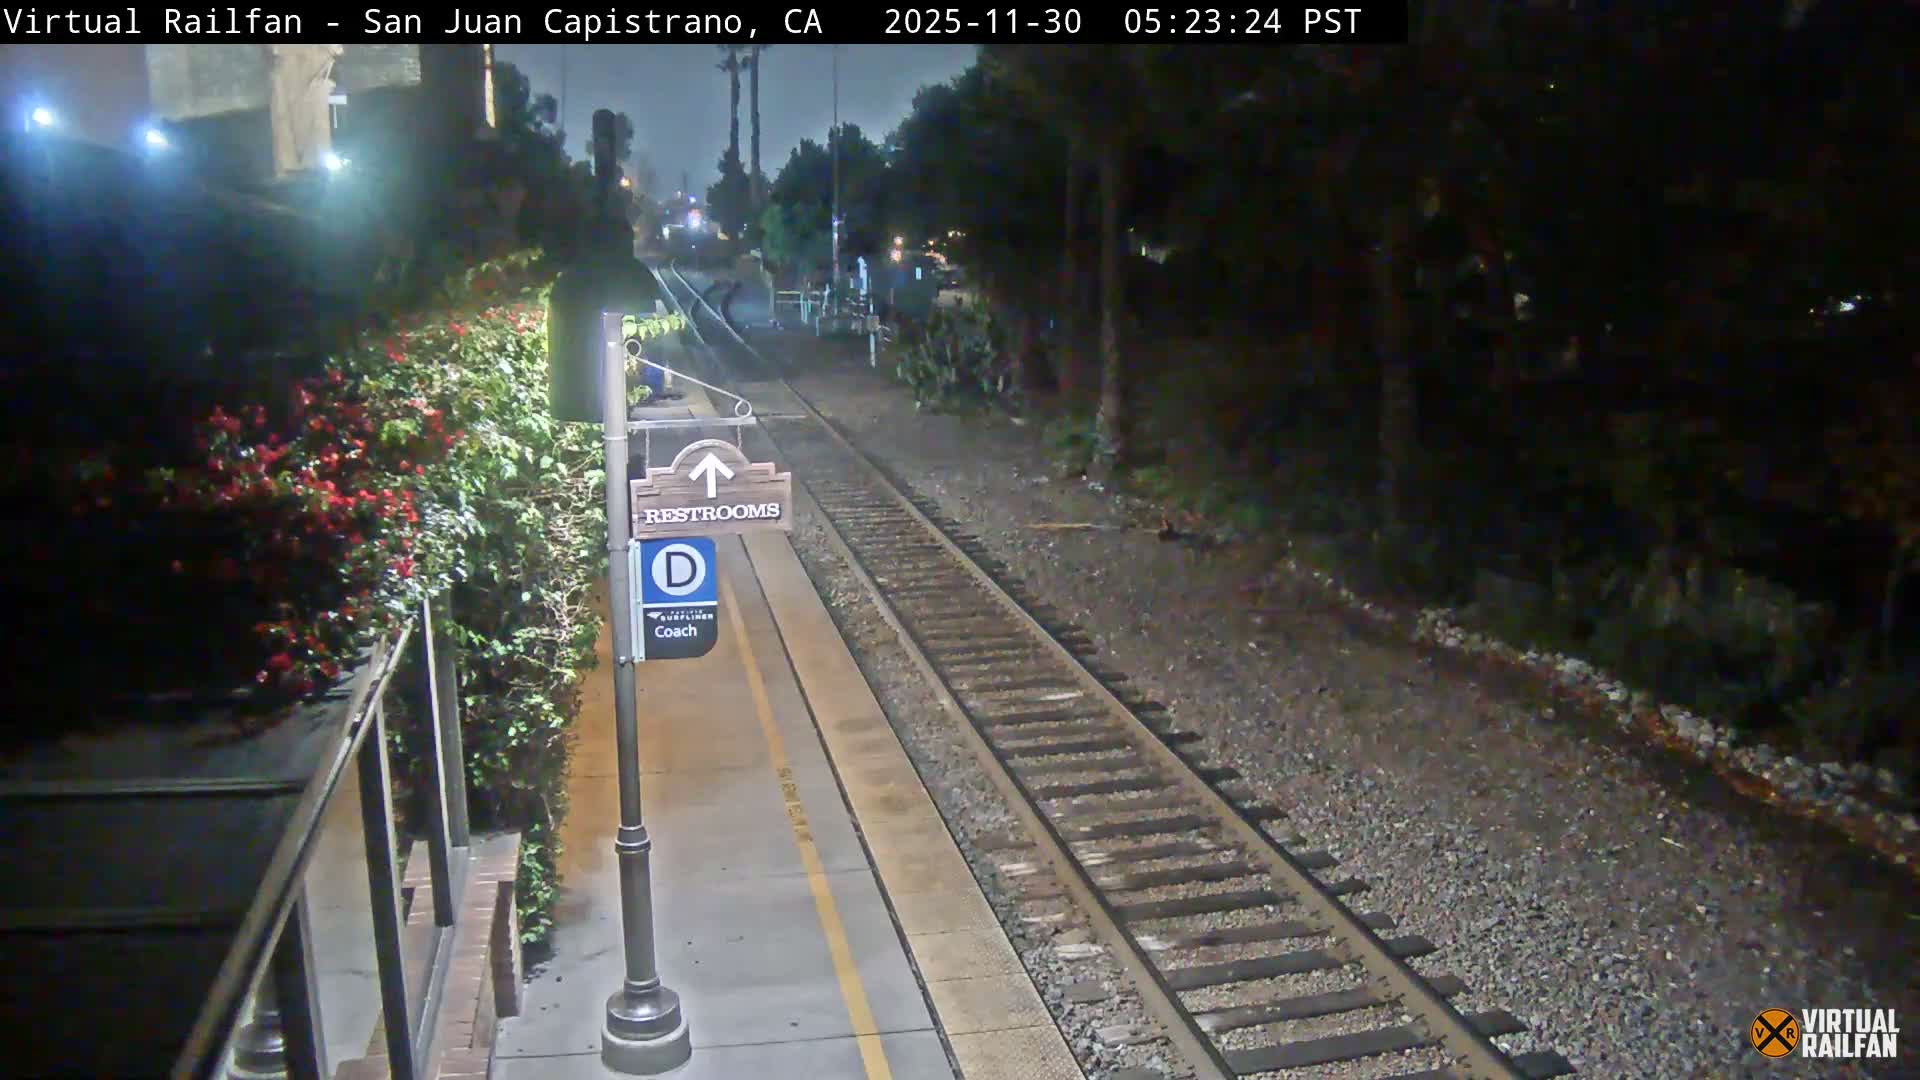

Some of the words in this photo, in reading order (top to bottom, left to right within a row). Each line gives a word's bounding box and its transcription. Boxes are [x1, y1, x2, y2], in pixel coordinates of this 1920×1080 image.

[644, 503, 780, 524] RESTROOMS
[665, 551, 697, 588] D
[654, 623, 697, 638] Coach
